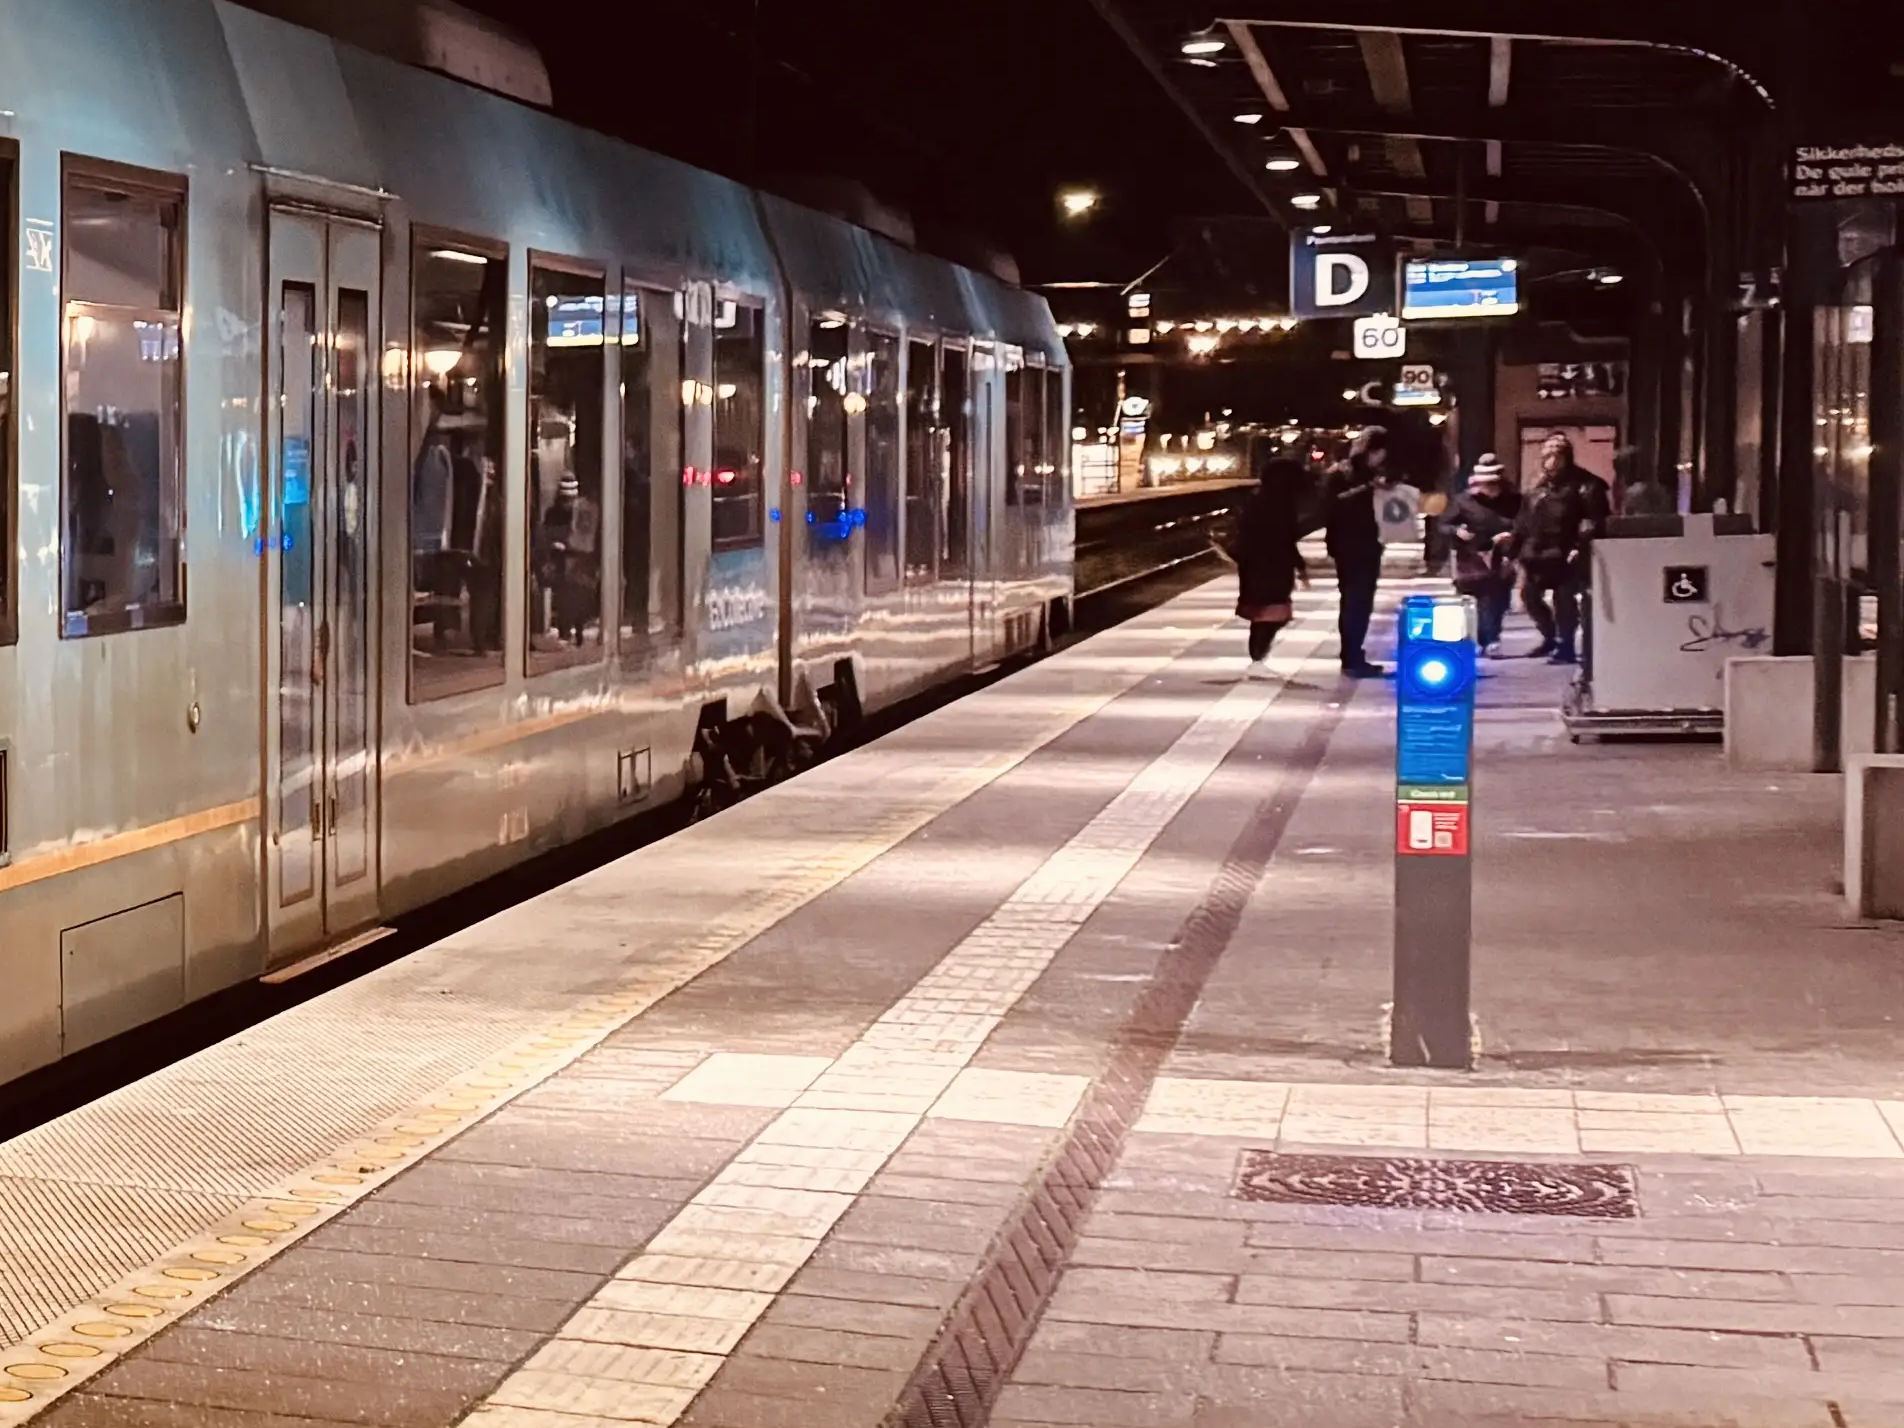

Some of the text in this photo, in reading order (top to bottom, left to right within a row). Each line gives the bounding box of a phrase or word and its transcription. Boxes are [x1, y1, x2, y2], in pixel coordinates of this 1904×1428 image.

[1314, 253, 1369, 307] D
[1362, 327, 1399, 348] 60
[1403, 370, 1430, 384] 90
